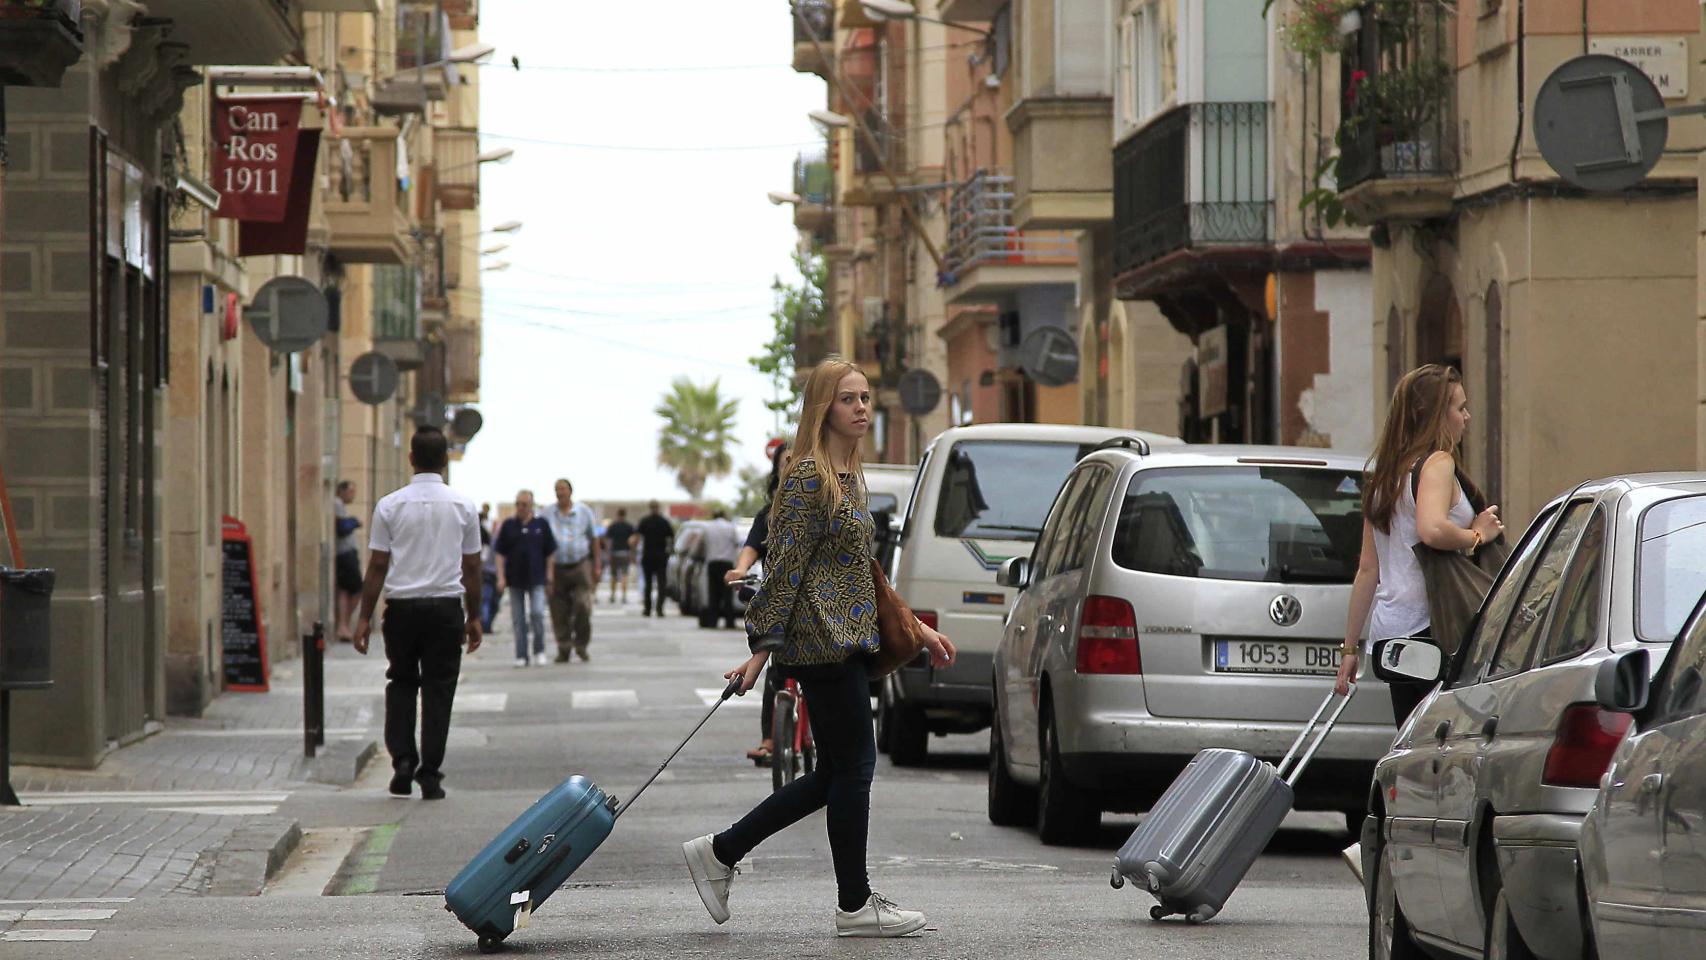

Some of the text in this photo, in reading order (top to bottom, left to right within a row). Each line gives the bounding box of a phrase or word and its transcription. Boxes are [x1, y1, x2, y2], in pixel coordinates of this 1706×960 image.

[1614, 46, 1662, 56] CARRER
[228, 105, 279, 131] Can
[228, 135, 278, 161] Ros
[224, 166, 278, 194] 1911
[1240, 642, 1289, 664] 1053
